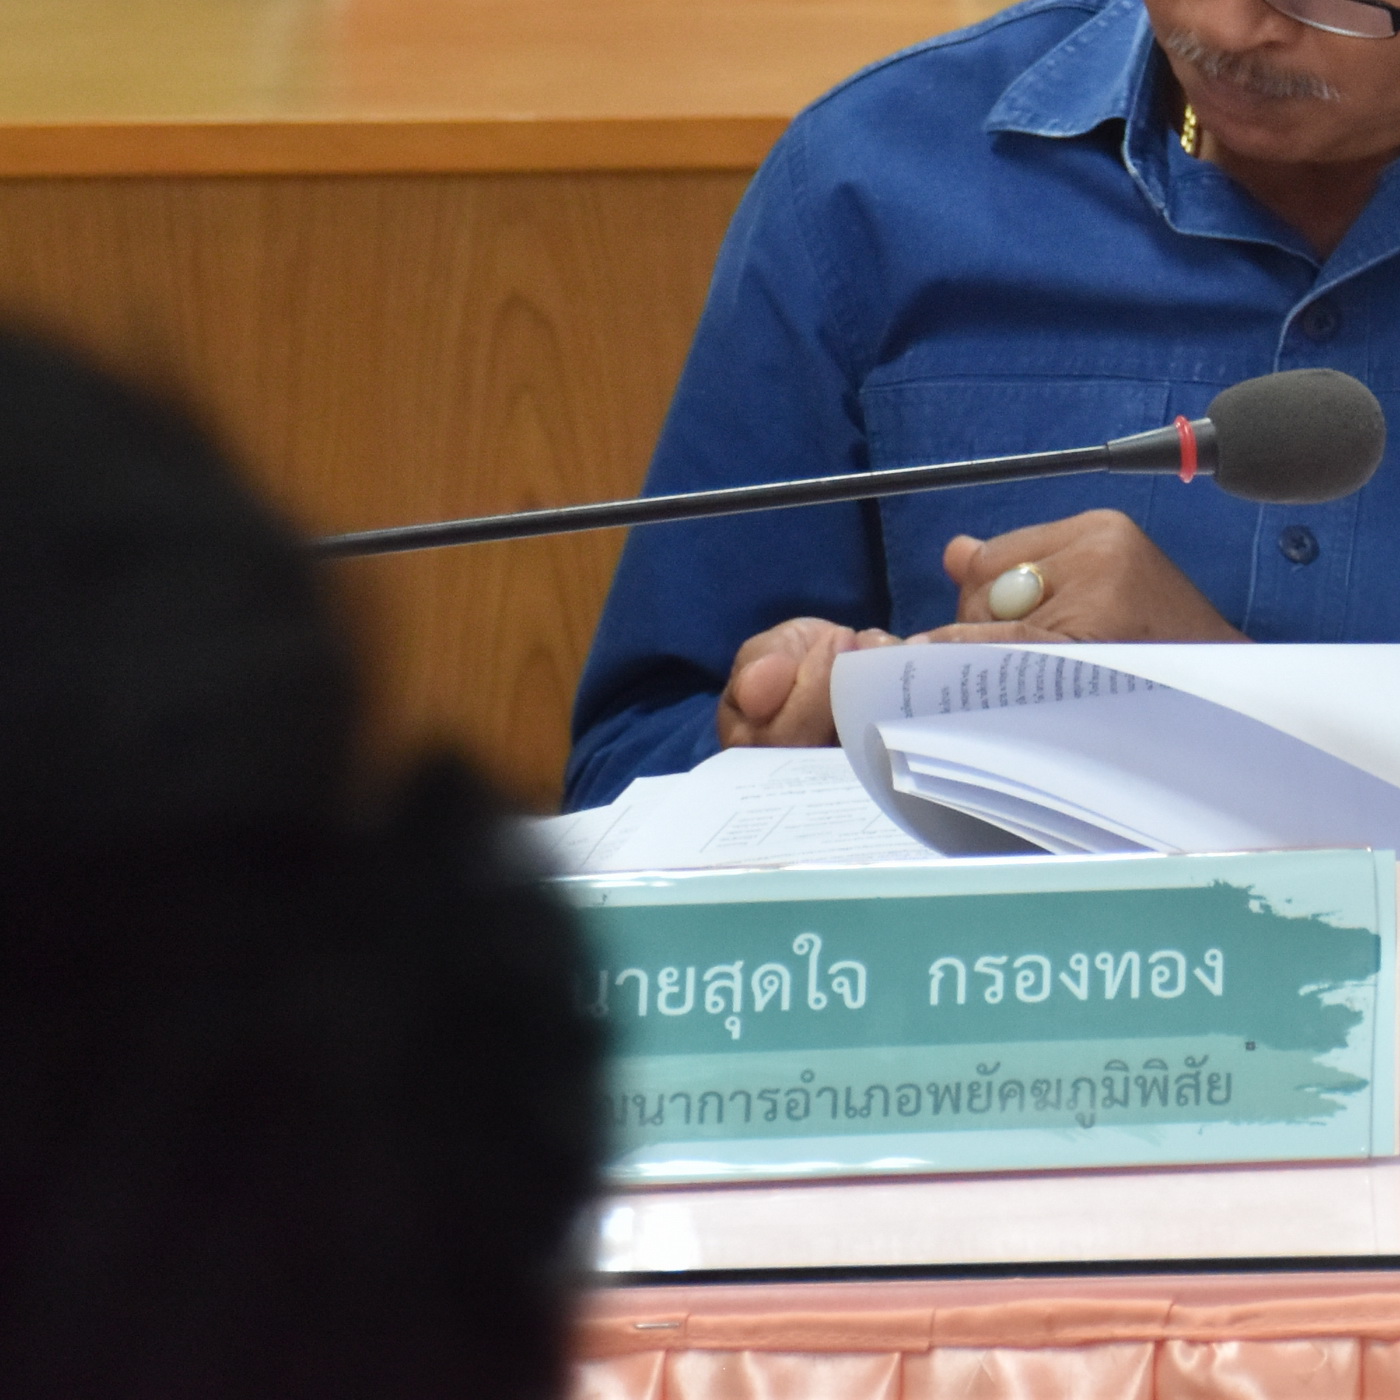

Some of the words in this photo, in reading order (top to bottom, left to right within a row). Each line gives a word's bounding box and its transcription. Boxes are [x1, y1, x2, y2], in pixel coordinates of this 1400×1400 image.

[929, 947, 1224, 1008] กรองทอง
[603, 1055, 1234, 1130] นาการอำเภอพยัคฆภูมิพิสัย
